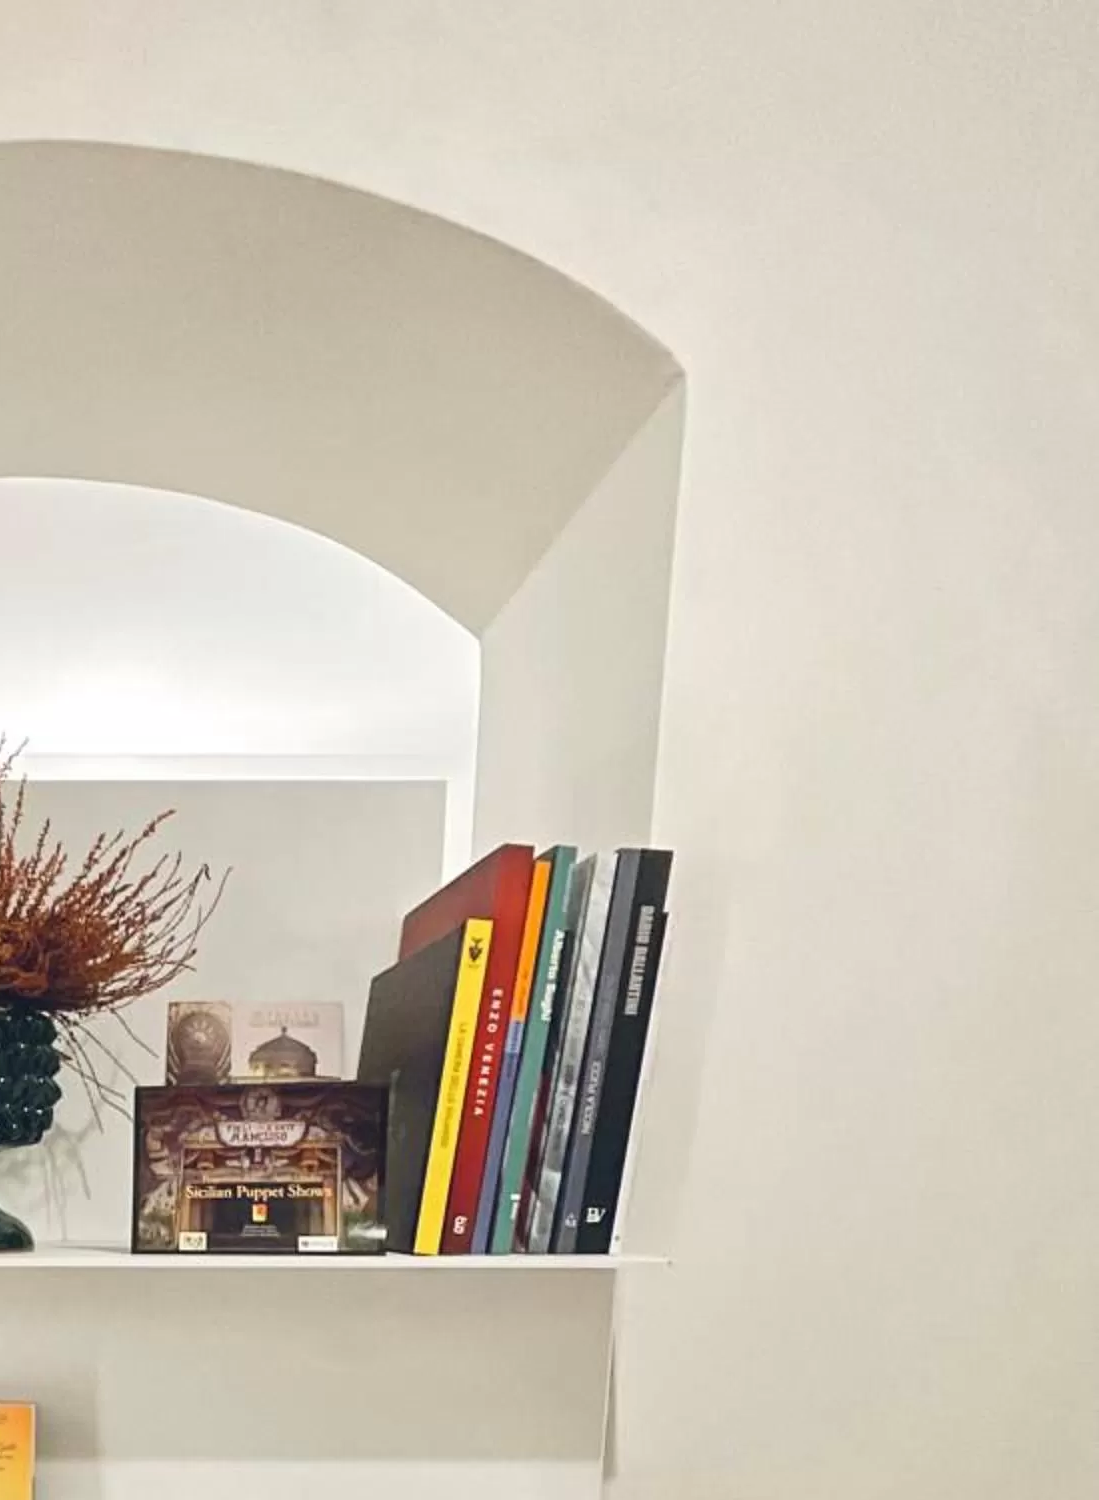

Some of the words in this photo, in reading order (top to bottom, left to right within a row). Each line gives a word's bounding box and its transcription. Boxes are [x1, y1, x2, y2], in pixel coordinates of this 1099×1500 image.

[486, 987, 503, 1034] ENZO
[473, 1041, 495, 1117] VENEZIA
[185, 1184, 233, 1199] Sicilian
[236, 1184, 284, 1202] Puppet
[287, 1184, 332, 1199] Shows
